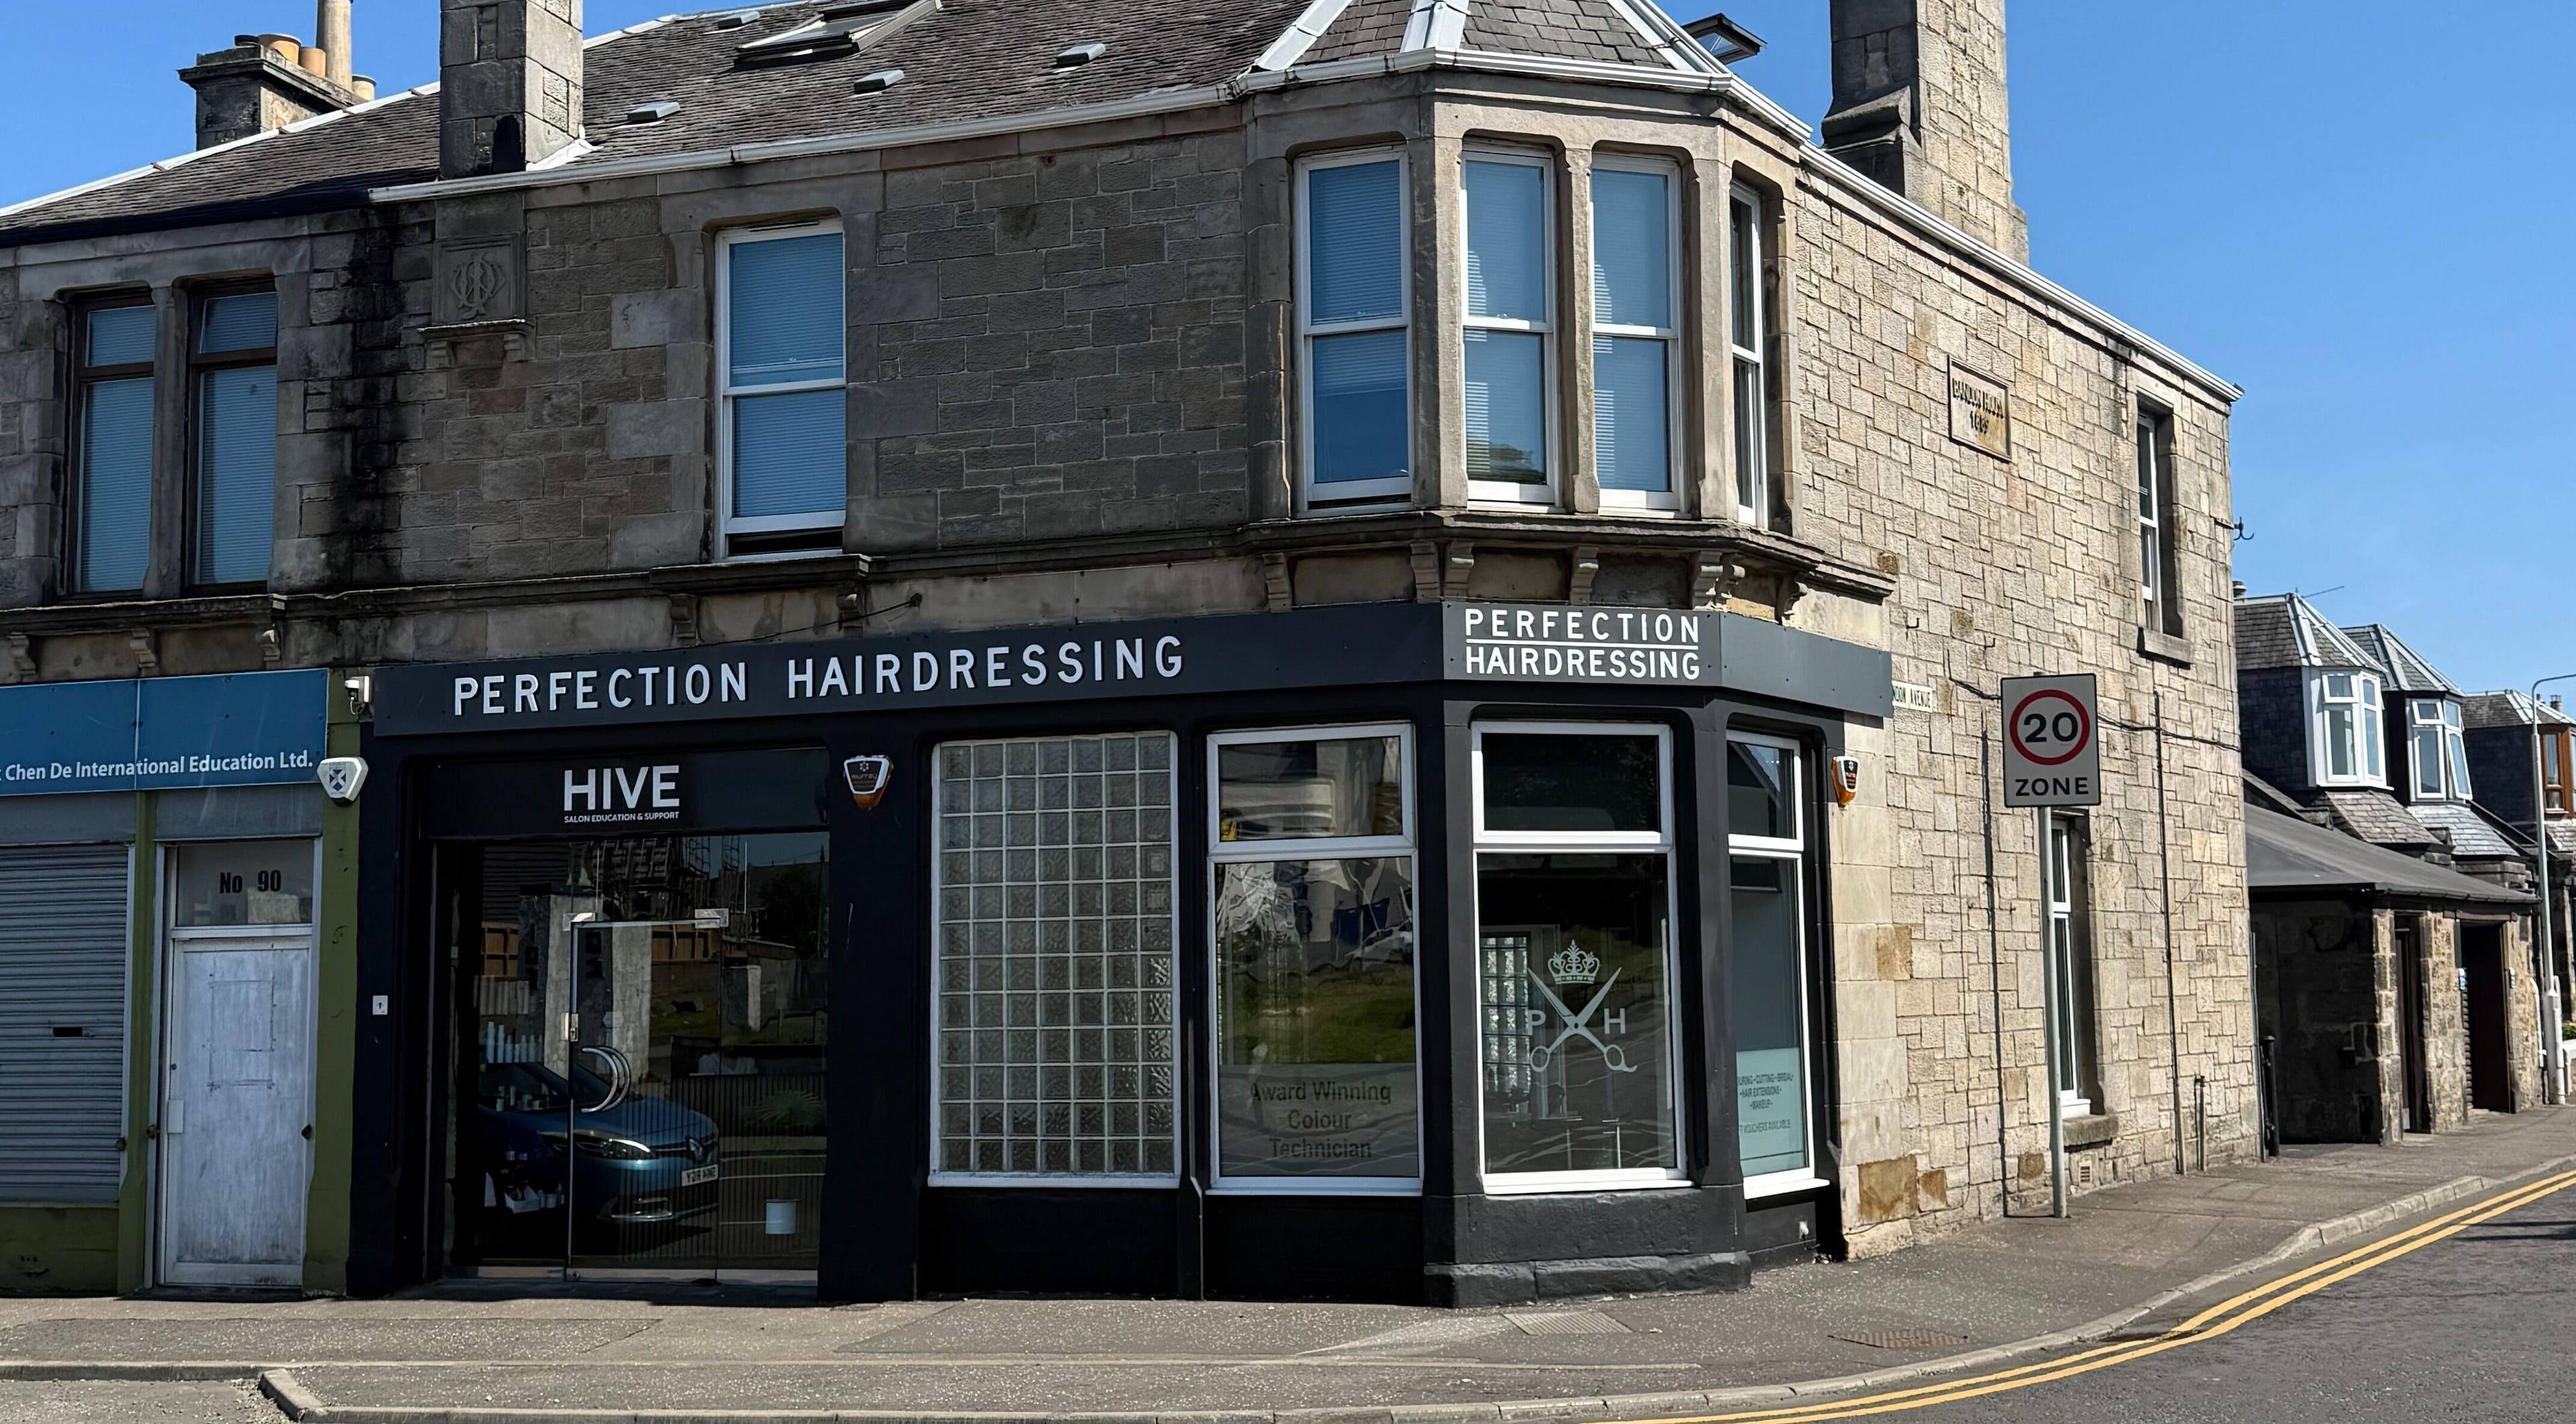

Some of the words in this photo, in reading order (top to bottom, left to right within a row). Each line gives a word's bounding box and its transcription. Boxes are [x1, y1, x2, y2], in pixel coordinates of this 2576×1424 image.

[1465, 608, 1699, 644] PERFECTION
[454, 661, 747, 716] PERFECTION
[788, 635, 1183, 699] HAIRDRESSING
[1465, 646, 1700, 680] HAIRDRESSING
[1910, 688, 1931, 708] AVENUE
[2023, 712, 2078, 743] 20
[5, 763, 46, 781] Chen
[50, 762, 72, 779] De
[76, 756, 184, 778] International
[189, 753, 274, 772] Education
[280, 750, 313, 768] Ltd.
[564, 765, 680, 811] HIVE
[2015, 777, 2089, 796] ZONE
[564, 815, 590, 823] SALON
[592, 813, 636, 822] EDUCATION
[644, 811, 680, 820] SUPPORT
[219, 871, 243, 893] No
[258, 869, 281, 892] 90
[1527, 1009, 1546, 1036] P
[1603, 1007, 1625, 1034] H
[1250, 1082, 1306, 1101] Award
[1313, 1081, 1391, 1105] Winning
[1288, 1109, 1352, 1130] Colour
[1269, 1138, 1372, 1158] Technician
